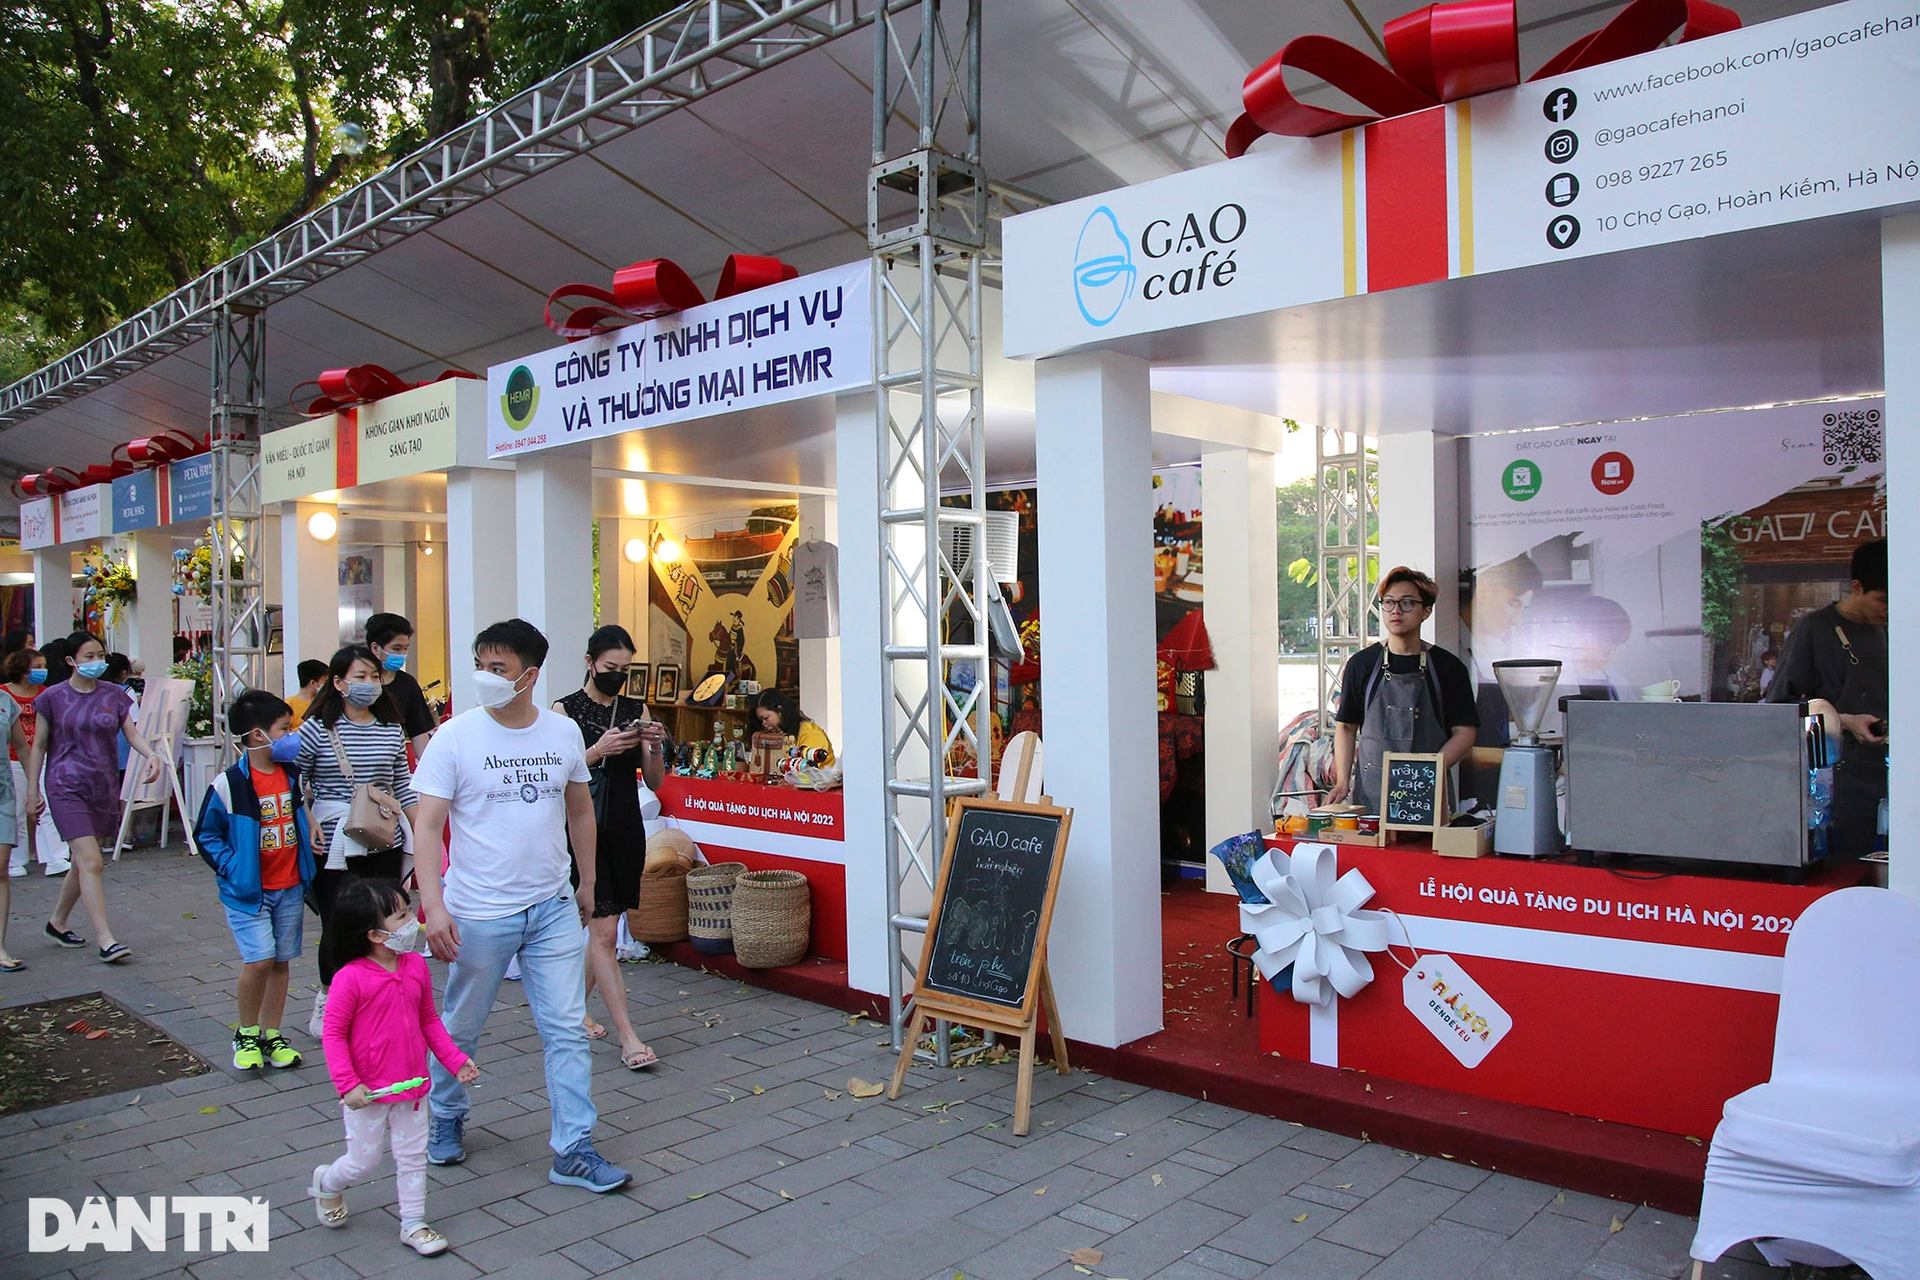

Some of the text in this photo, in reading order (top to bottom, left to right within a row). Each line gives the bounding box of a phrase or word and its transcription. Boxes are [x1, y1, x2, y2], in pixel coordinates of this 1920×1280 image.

[1594, 98, 1746, 148] @gaocafehanoi
[1595, 150, 1728, 190] 098 9227 265
[1597, 216, 1618, 232] 10
[1623, 208, 1662, 226] Chợ
[1667, 202, 1711, 220] Gạo,
[1717, 190, 1772, 211] Hoàn
[1780, 177, 1840, 200] Kiếm,
[1848, 167, 1878, 188] Hà
[1141, 203, 1247, 259] GẠO
[1142, 249, 1238, 301] café
[555, 285, 843, 388] CÔNG TY TNHH DỊCH VỤ
[509, 388, 531, 404] HEMR
[561, 346, 833, 432] VÀ THƯƠNG MẠI HEMR
[365, 421, 388, 439] KHÔNG
[388, 417, 405, 433] GIAN
[1577, 436, 1602, 445] NGAY
[409, 437, 422, 455] TẠO
[1509, 488, 1535, 496] GrabFood
[483, 752, 563, 770] Abercrombie
[502, 768, 548, 784] & Fitch
[685, 795, 834, 826] LỄ HỘI QUÀ TẶNG DU LỊCH HÀ NỘI 2022
[970, 827, 1044, 854] GAO café
[1419, 876, 1797, 934] LỄ HỘI QUÀ TẶNG DU LỊCH HÀ NỘI 202
[950, 949, 975, 968] trên
[961, 973, 970, 984] 10
